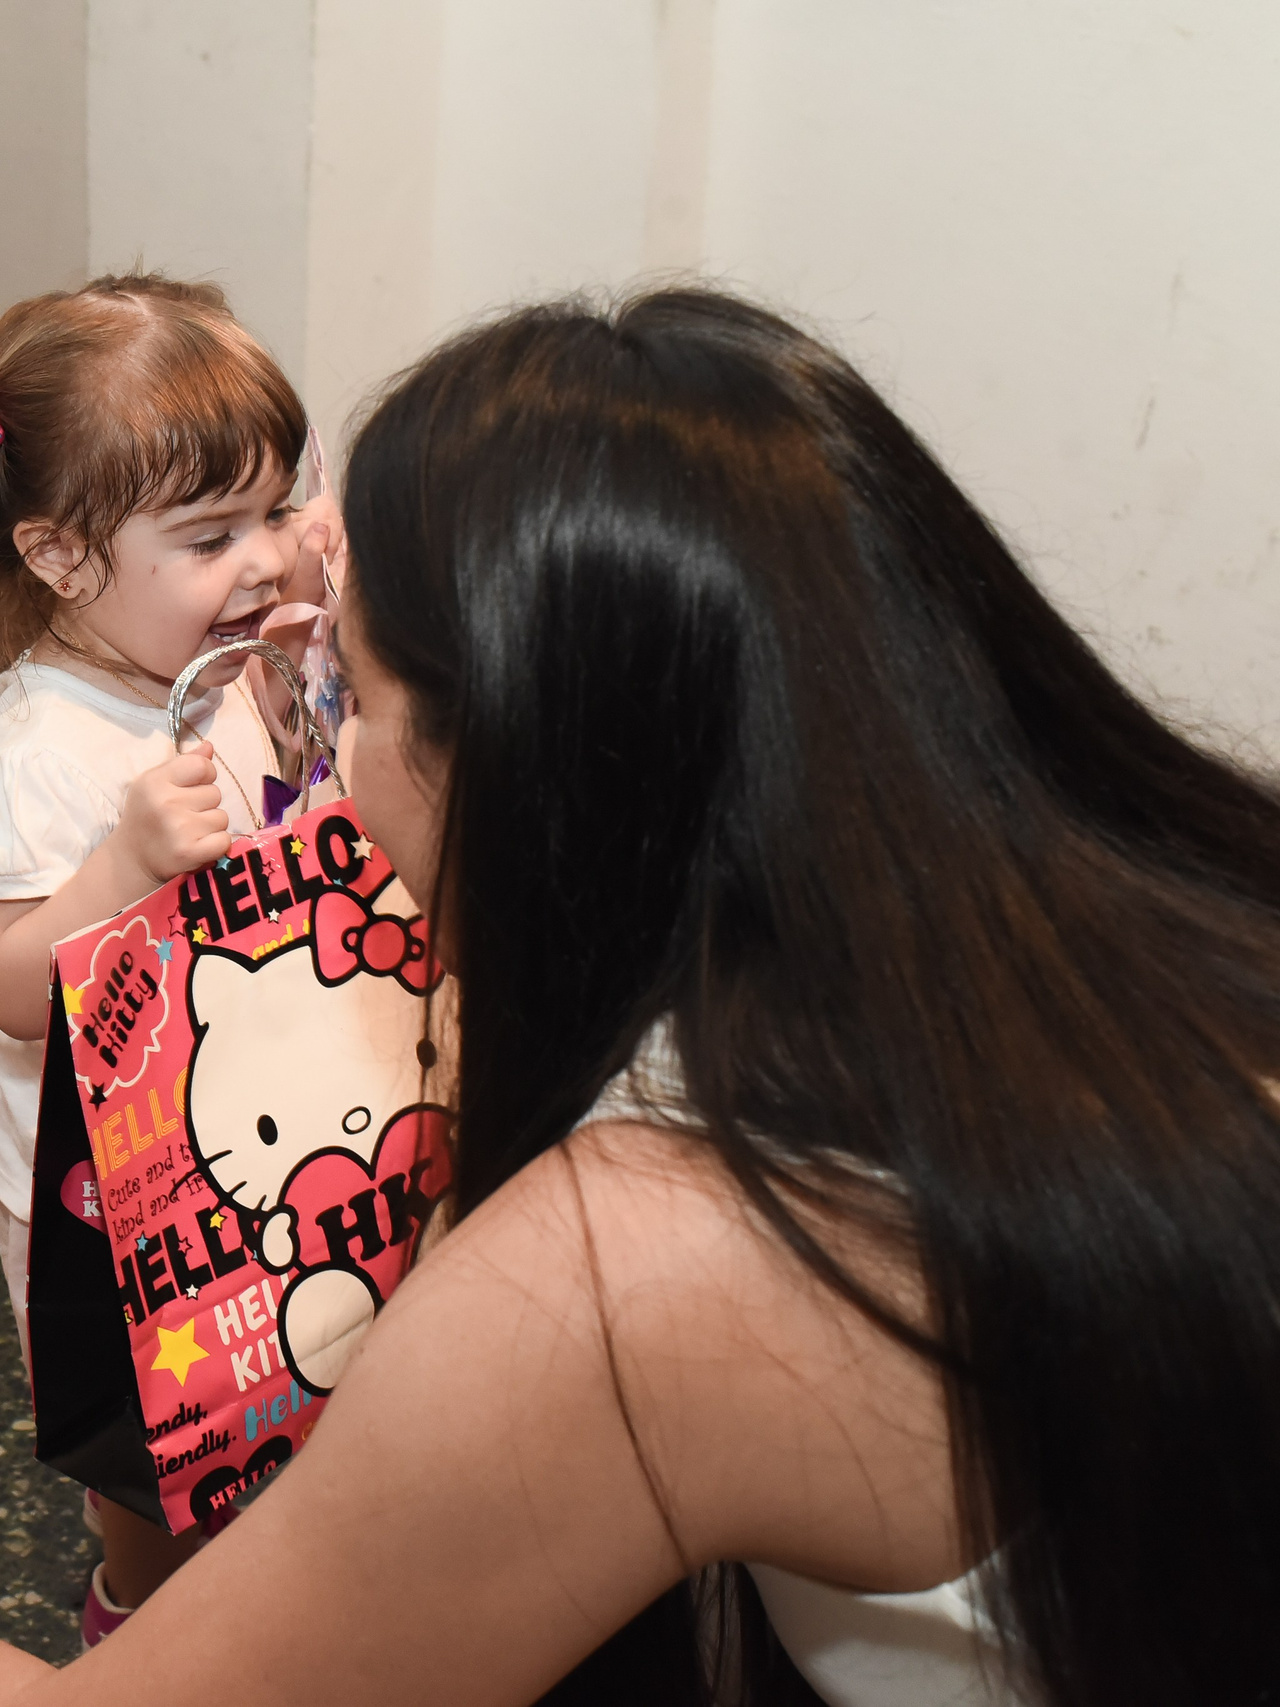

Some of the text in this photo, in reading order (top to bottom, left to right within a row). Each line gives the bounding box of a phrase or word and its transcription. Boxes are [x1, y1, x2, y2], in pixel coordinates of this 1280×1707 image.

[178, 815, 365, 948] HELLO
[82, 951, 133, 1048] Hello
[98, 968, 158, 1069] Kitty
[107, 1173, 141, 1212] Cute
[145, 1145, 175, 1184] and
[112, 1201, 145, 1245] kind
[149, 1178, 180, 1217] and
[315, 1157, 433, 1263] HK
